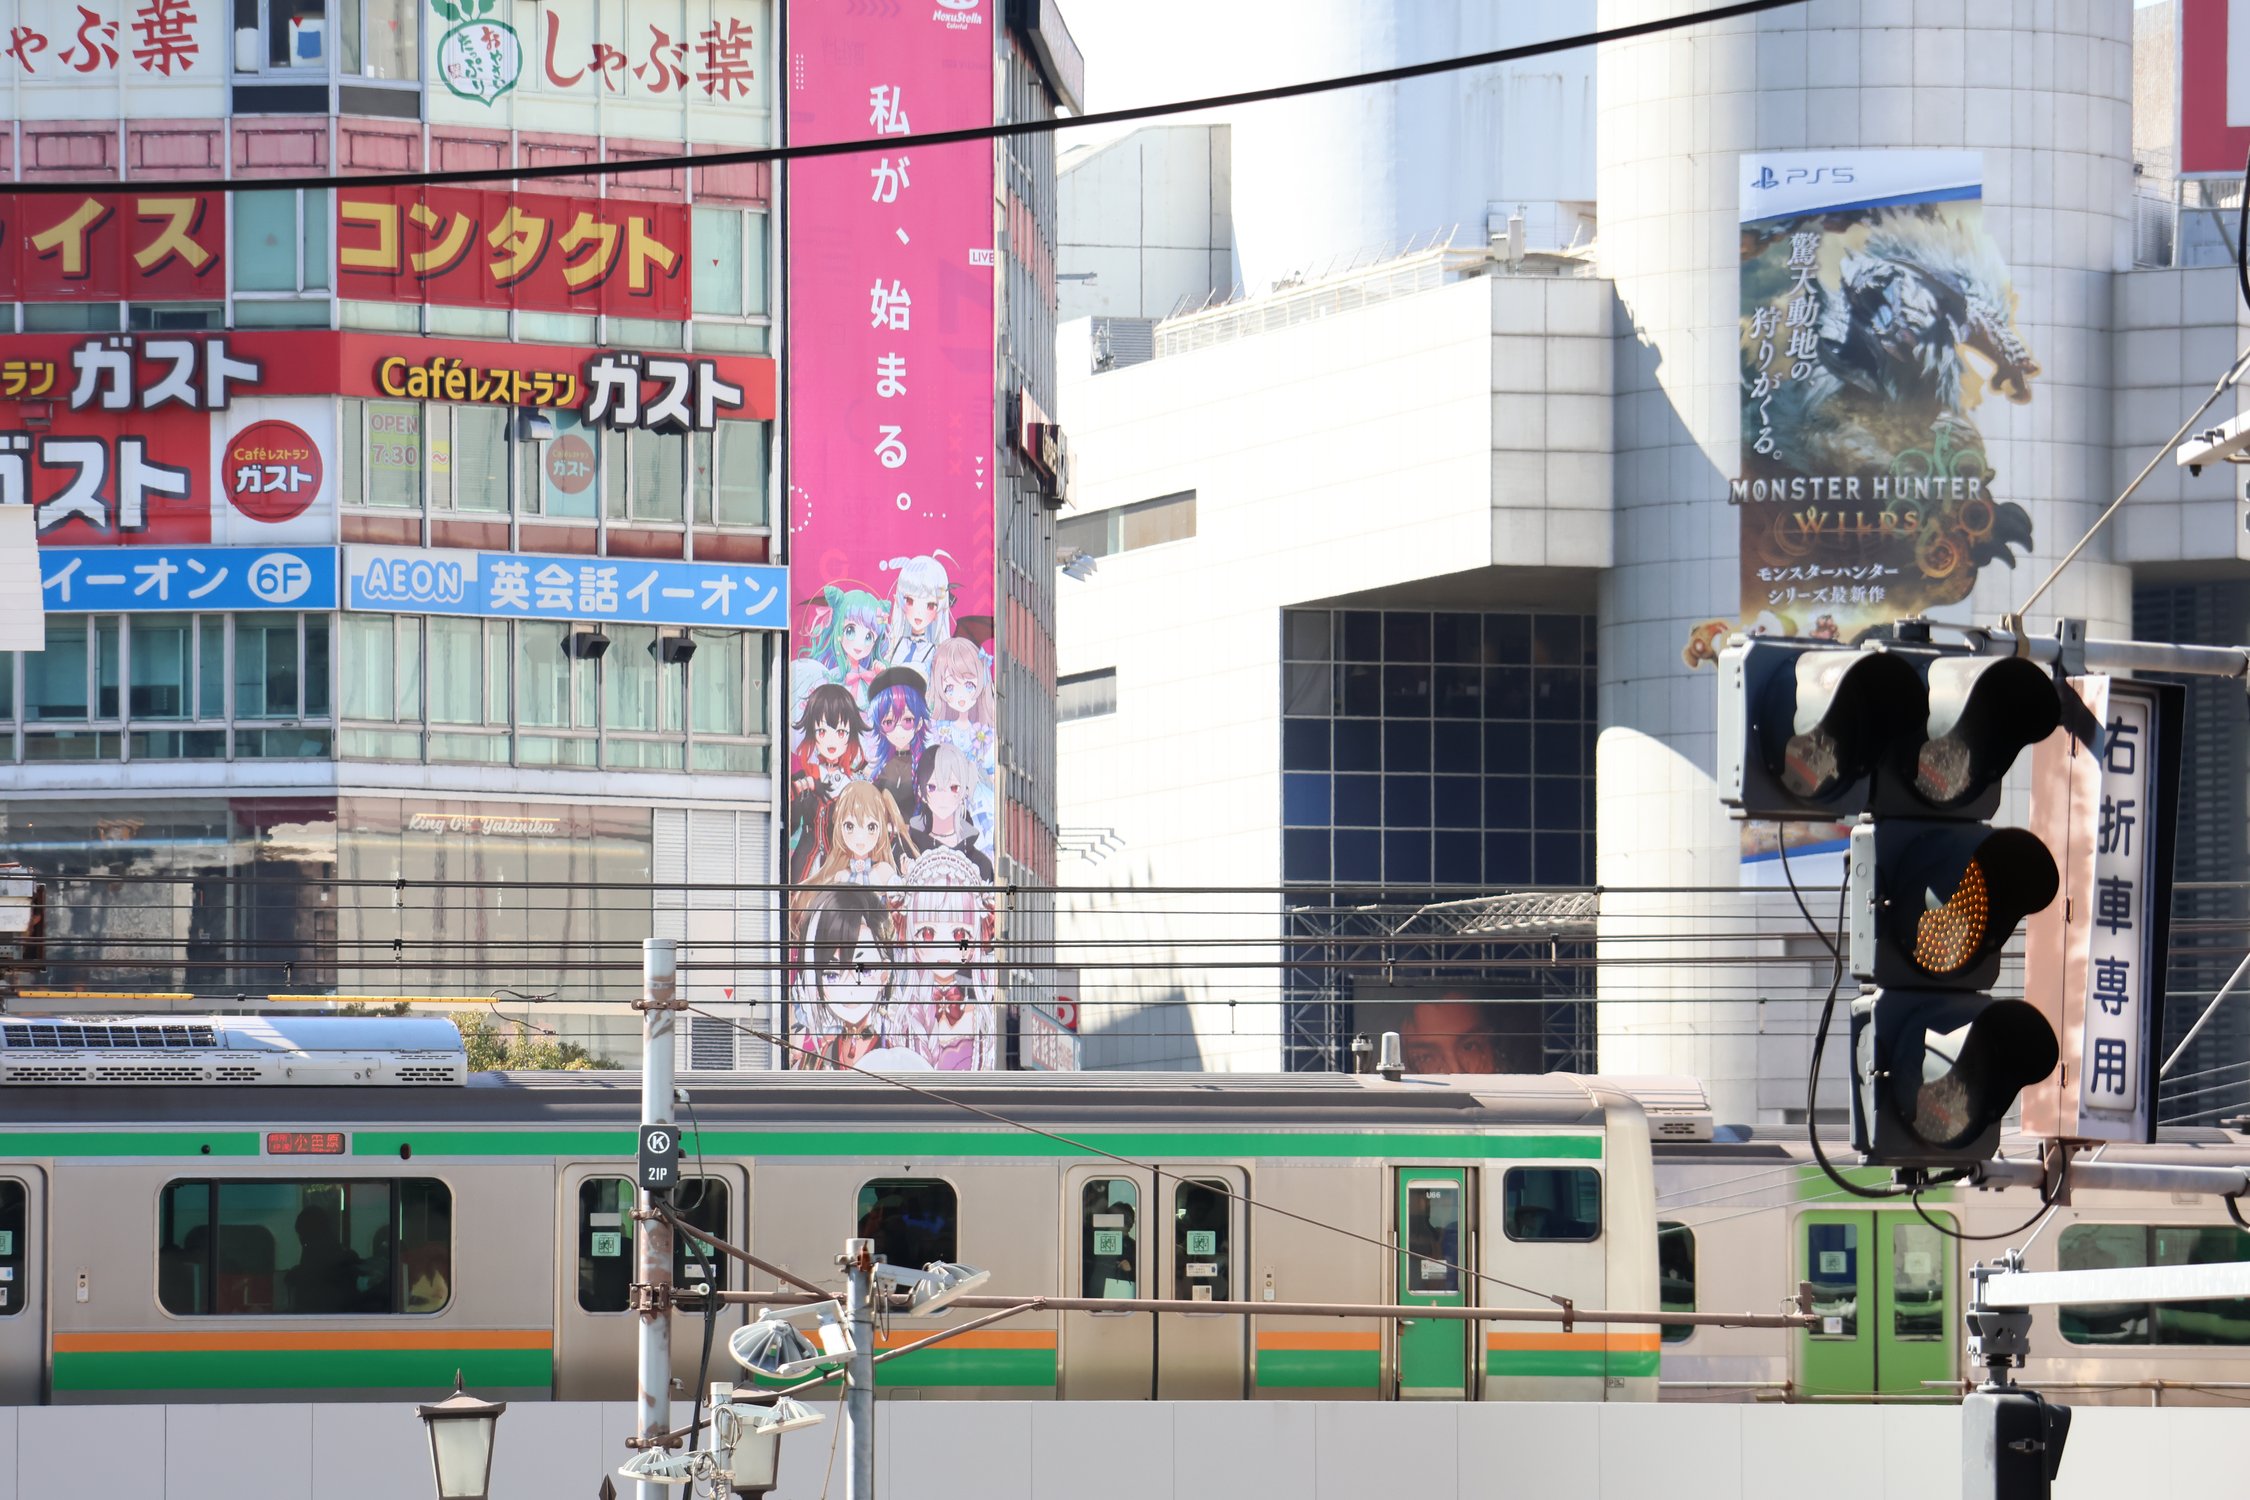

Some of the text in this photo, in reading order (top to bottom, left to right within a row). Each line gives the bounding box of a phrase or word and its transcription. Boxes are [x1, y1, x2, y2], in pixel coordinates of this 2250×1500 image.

[0, 0, 200, 77] ゃぶ葉
[545, 9, 755, 102] しゃぶ葉
[1786, 167, 1855, 184] PS5
[341, 201, 676, 289] コンタクト
[972, 251, 994, 263] LIVE
[869, 84, 912, 511] 私が、始まる。
[72, 337, 258, 409] ガスト
[1750, 306, 1783, 461] 狩りがくる。
[587, 354, 741, 430] ガスト
[371, 414, 418, 433] OPEN
[372, 444, 418, 465] 7:30
[553, 460, 591, 477] ガスト
[236, 464, 312, 493] ガスト
[1730, 476, 1982, 503] MONSTER HUNTER
[1794, 505, 1919, 533] WILDS
[43, 558, 303, 602] イーオン 6F
[366, 560, 461, 601] AEON
[491, 561, 779, 616] 英会話イーオン
[1757, 563, 1899, 583] モンスターハンター
[1769, 585, 1887, 605] シリーズ最新作
[408, 814, 445, 835] King
[481, 817, 556, 835] Yakiniku
[2090, 716, 2139, 1096] 右折車専用
